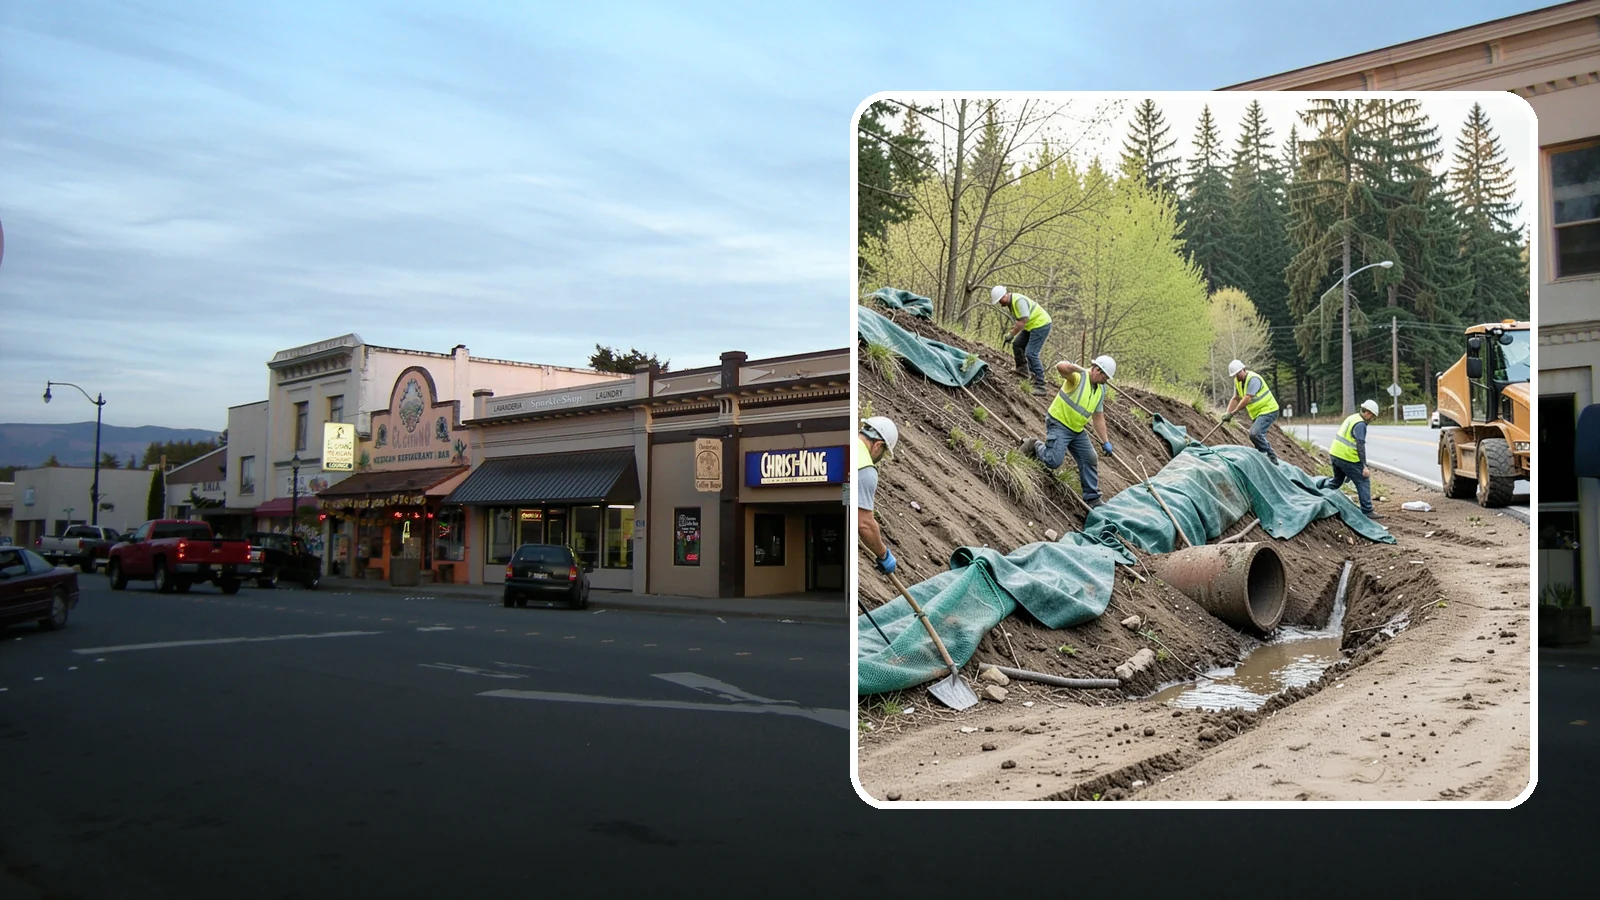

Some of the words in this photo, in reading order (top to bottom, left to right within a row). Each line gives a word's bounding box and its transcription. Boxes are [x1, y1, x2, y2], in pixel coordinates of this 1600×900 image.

[562, 394, 583, 405] Shop
[596, 389, 623, 400] LAUNDRY
[493, 402, 522, 412] LAVANDERIA
[392, 425, 401, 449] EL
[373, 454, 396, 463] MEXICAN
[397, 451, 433, 462] RESTAURANT
[438, 450, 450, 459] BAR
[761, 452, 797, 478] CHRIST
[799, 450, 828, 477] KING
